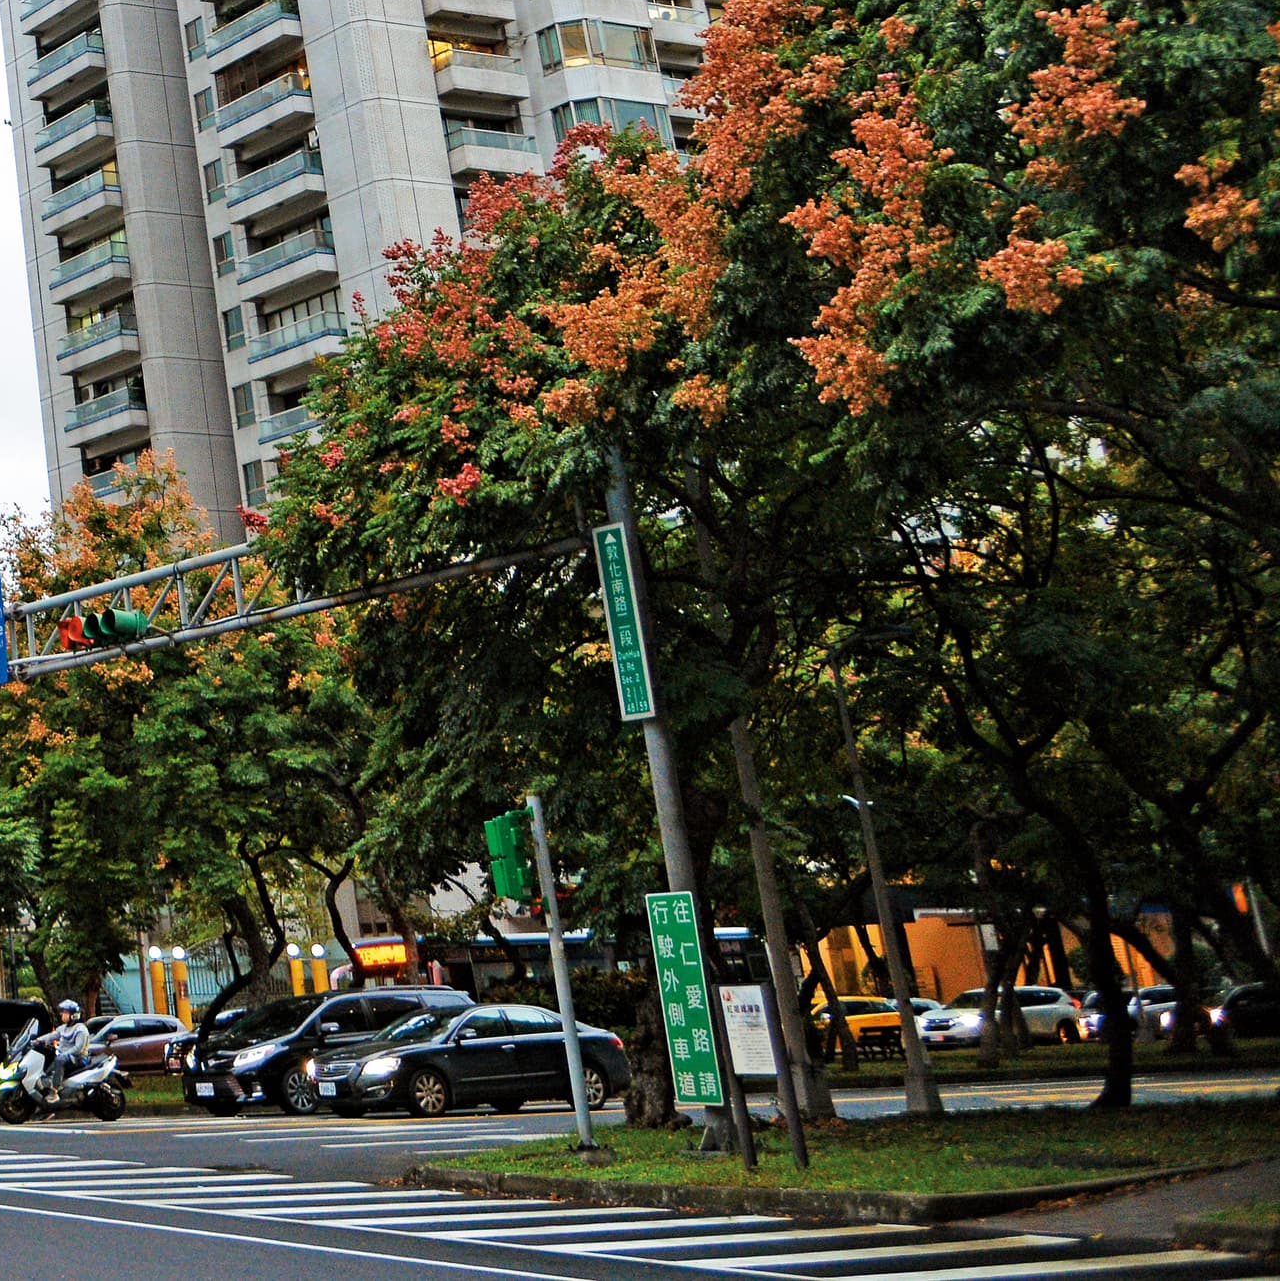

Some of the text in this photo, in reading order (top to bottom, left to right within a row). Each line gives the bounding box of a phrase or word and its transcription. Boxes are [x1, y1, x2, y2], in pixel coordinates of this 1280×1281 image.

[606, 545, 633, 647] 敦化南路二段
[651, 900, 697, 1098] 行駛外側車道
[672, 898, 717, 1098] 往仁愛路請
